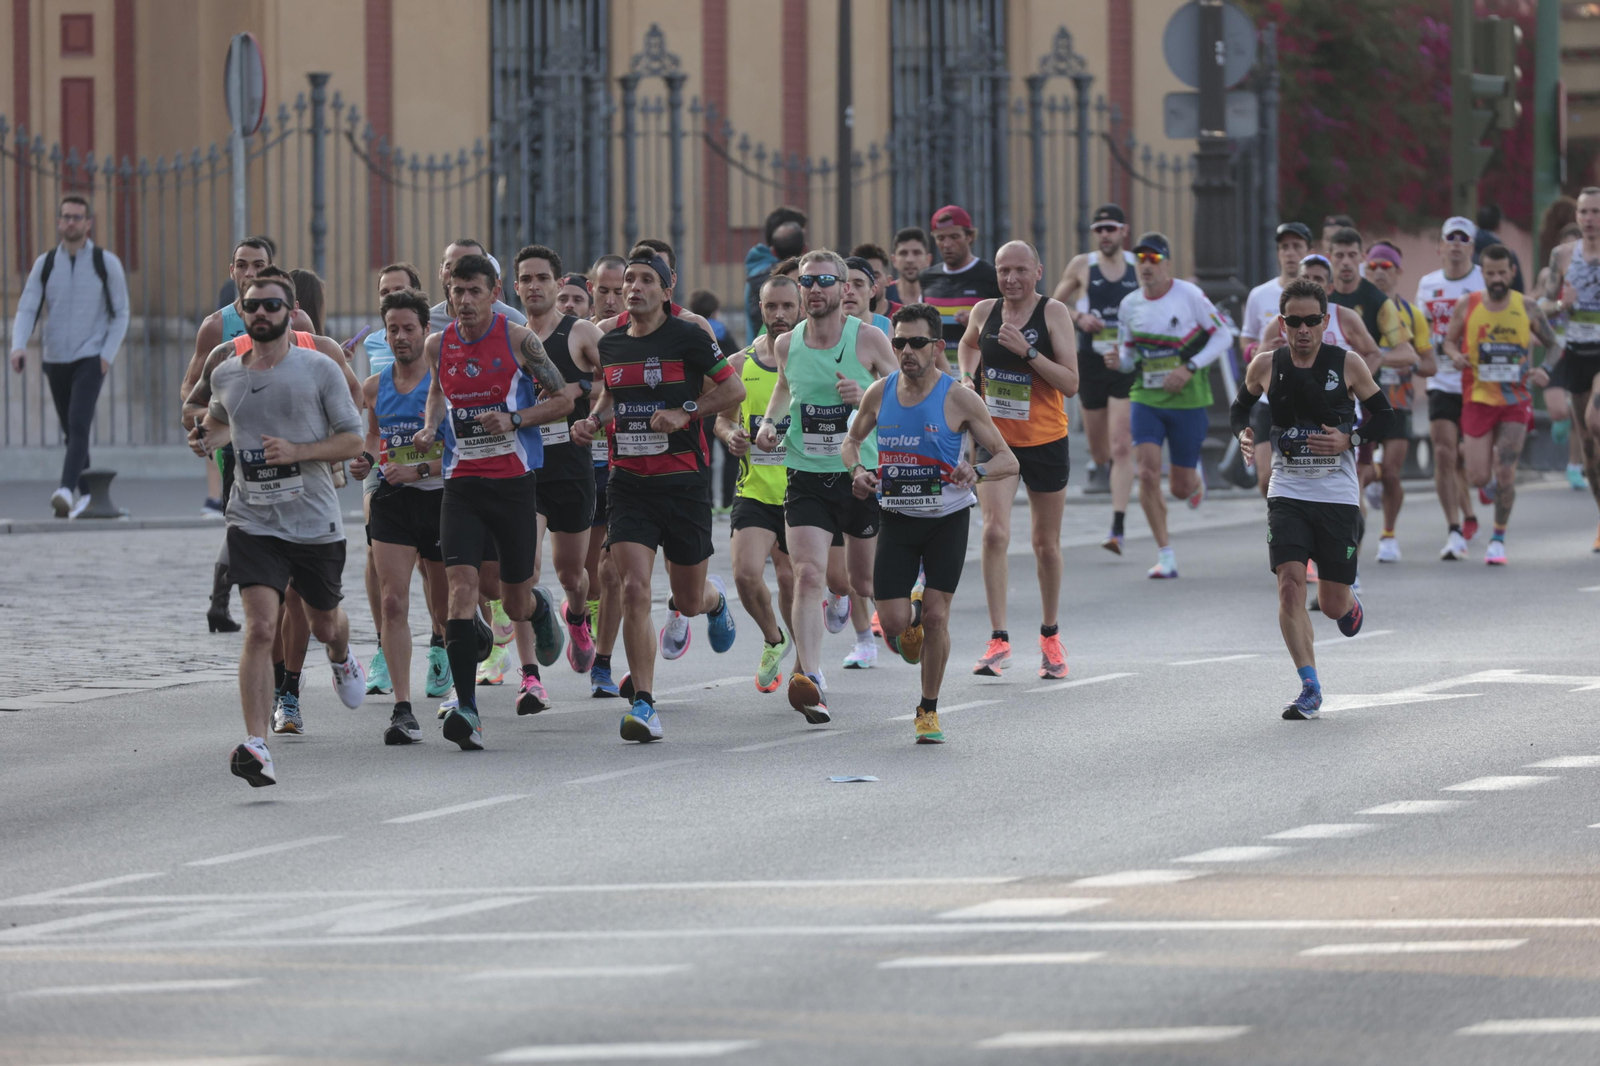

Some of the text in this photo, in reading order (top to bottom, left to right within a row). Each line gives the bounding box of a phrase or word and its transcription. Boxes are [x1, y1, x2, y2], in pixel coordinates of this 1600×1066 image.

[997, 372, 1026, 383] ZURICH
[450, 391, 490, 400] OriginalPerfil
[998, 388, 1011, 396] 974
[816, 406, 846, 416] ZURICH
[628, 422, 648, 430] 2854
[464, 435, 506, 446] NAZABOBODA
[257, 468, 278, 478] 2607
[900, 468, 934, 476] ZURICH
[260, 482, 281, 490] COLIN
[902, 485, 922, 494] 2902
